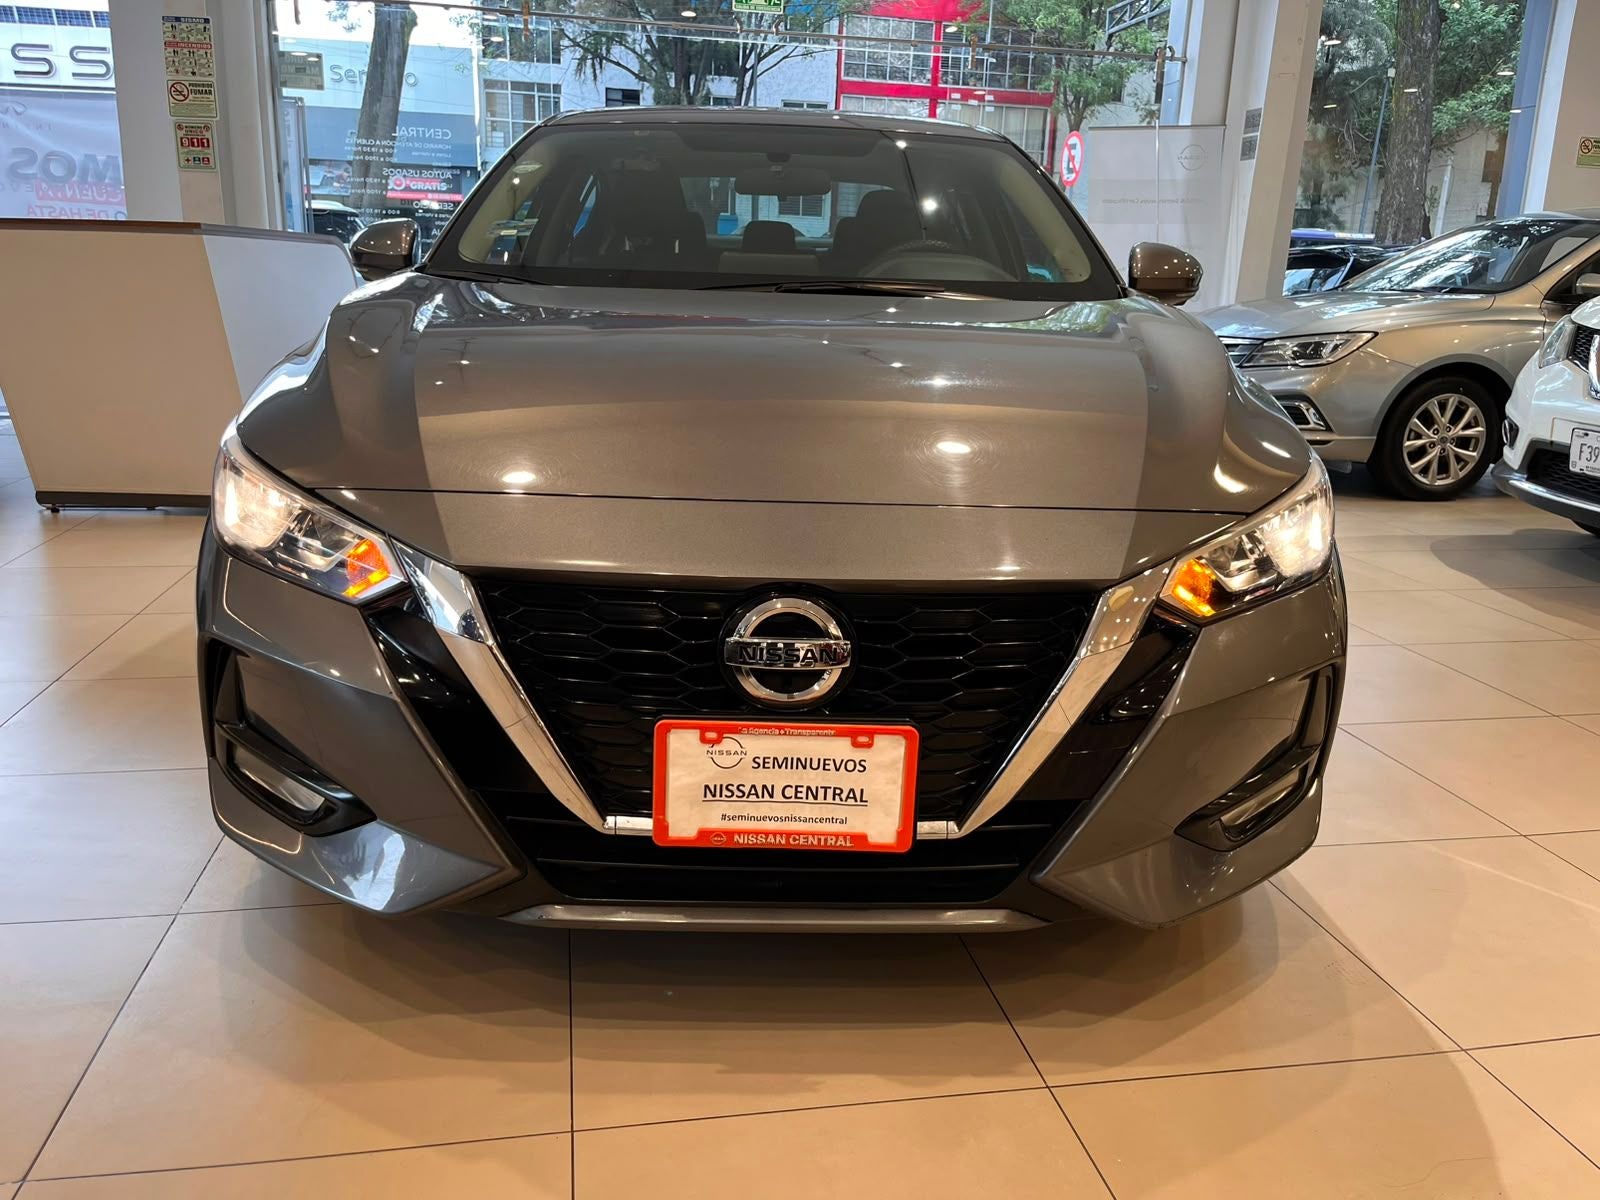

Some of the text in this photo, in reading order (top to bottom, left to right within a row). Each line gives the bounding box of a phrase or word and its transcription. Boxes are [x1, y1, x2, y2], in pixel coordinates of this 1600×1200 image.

[11, 43, 113, 80] SS
[409, 181, 448, 191] GRATIS
[739, 646, 839, 665] NISSAN
[751, 756, 867, 773] SEMINUEVOS
[703, 783, 868, 803] NISSAN CENTRAL
[720, 813, 848, 825] #seminuevosnissancentral
[733, 832, 854, 847] NISSAN CENTRAL
